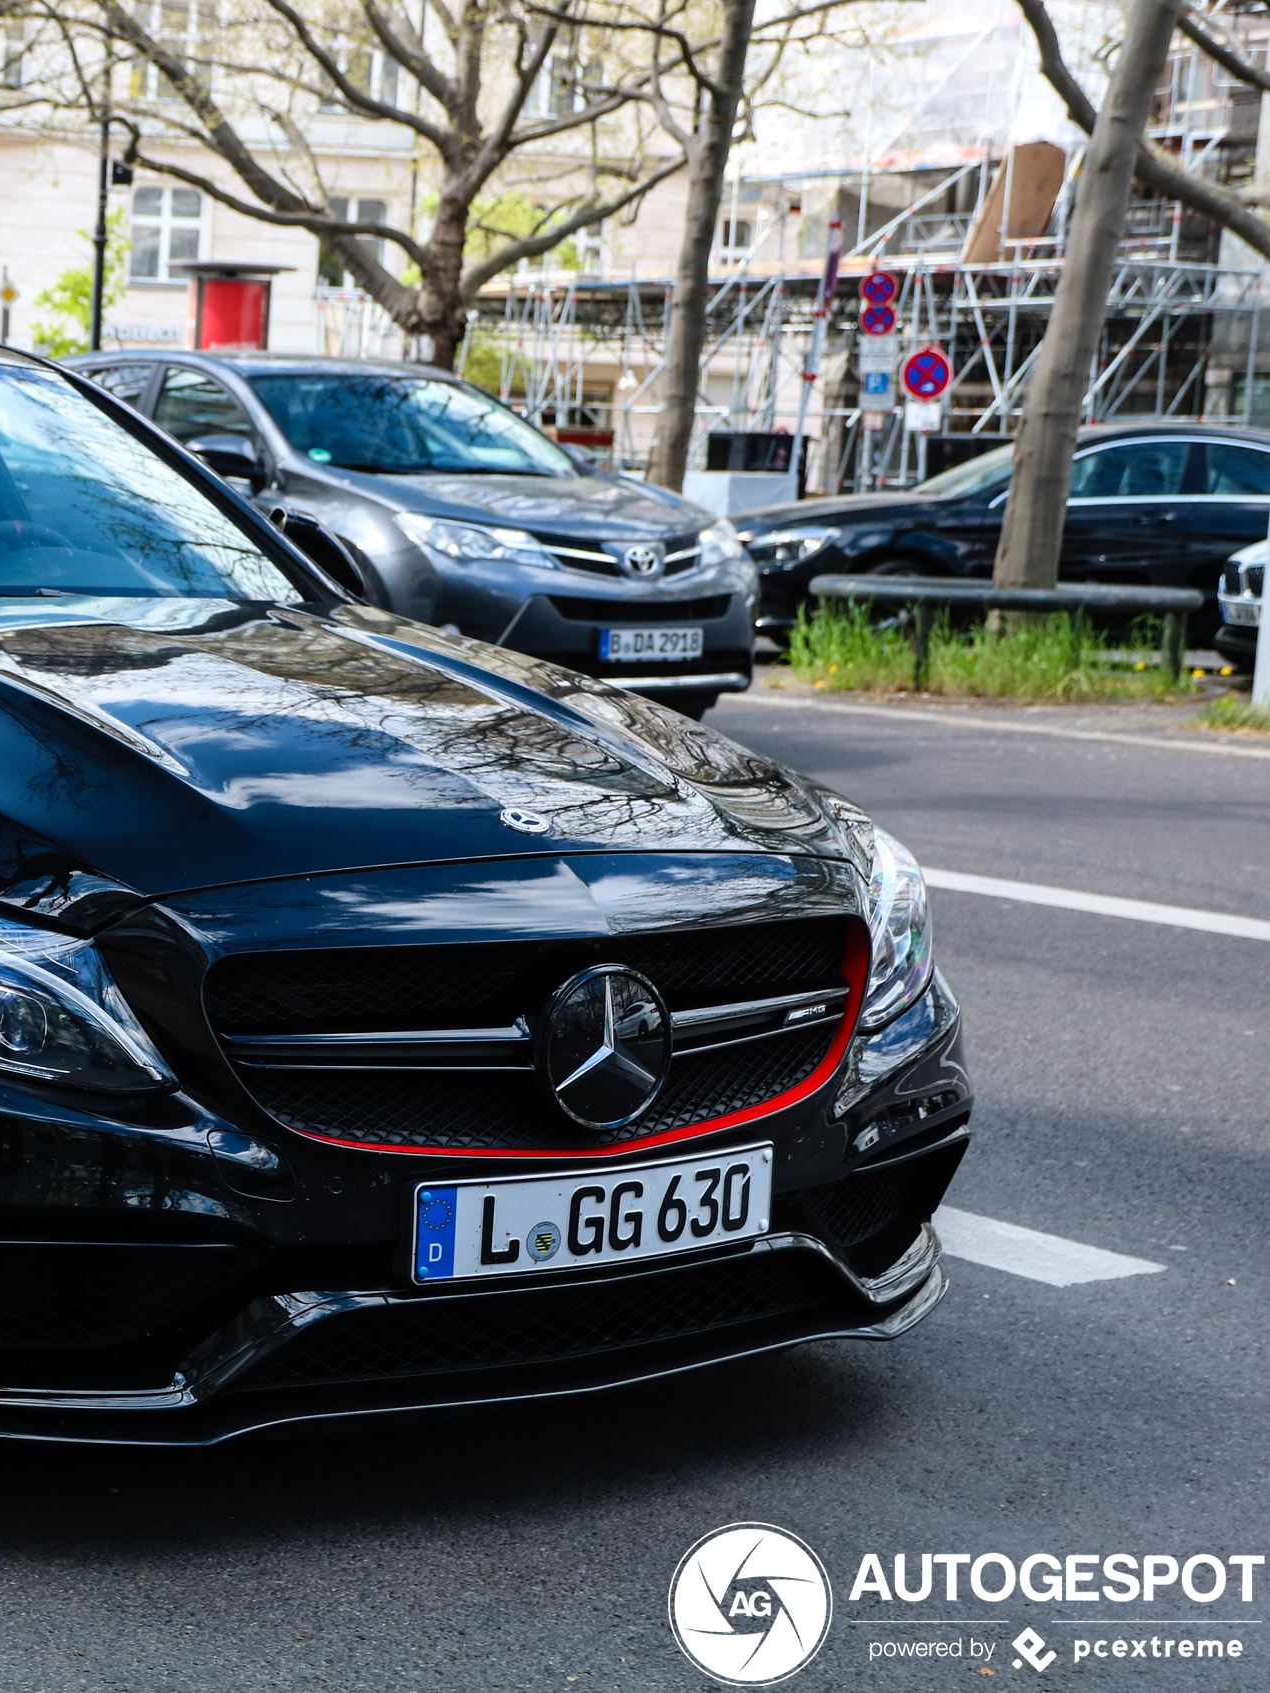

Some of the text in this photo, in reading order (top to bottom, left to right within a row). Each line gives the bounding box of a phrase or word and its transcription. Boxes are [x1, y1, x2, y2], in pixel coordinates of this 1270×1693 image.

[610, 632, 700, 654] B DA 2918
[795, 1004, 826, 1019] AMG
[480, 1162, 752, 1265] L GG 630
[428, 1242, 443, 1263] D
